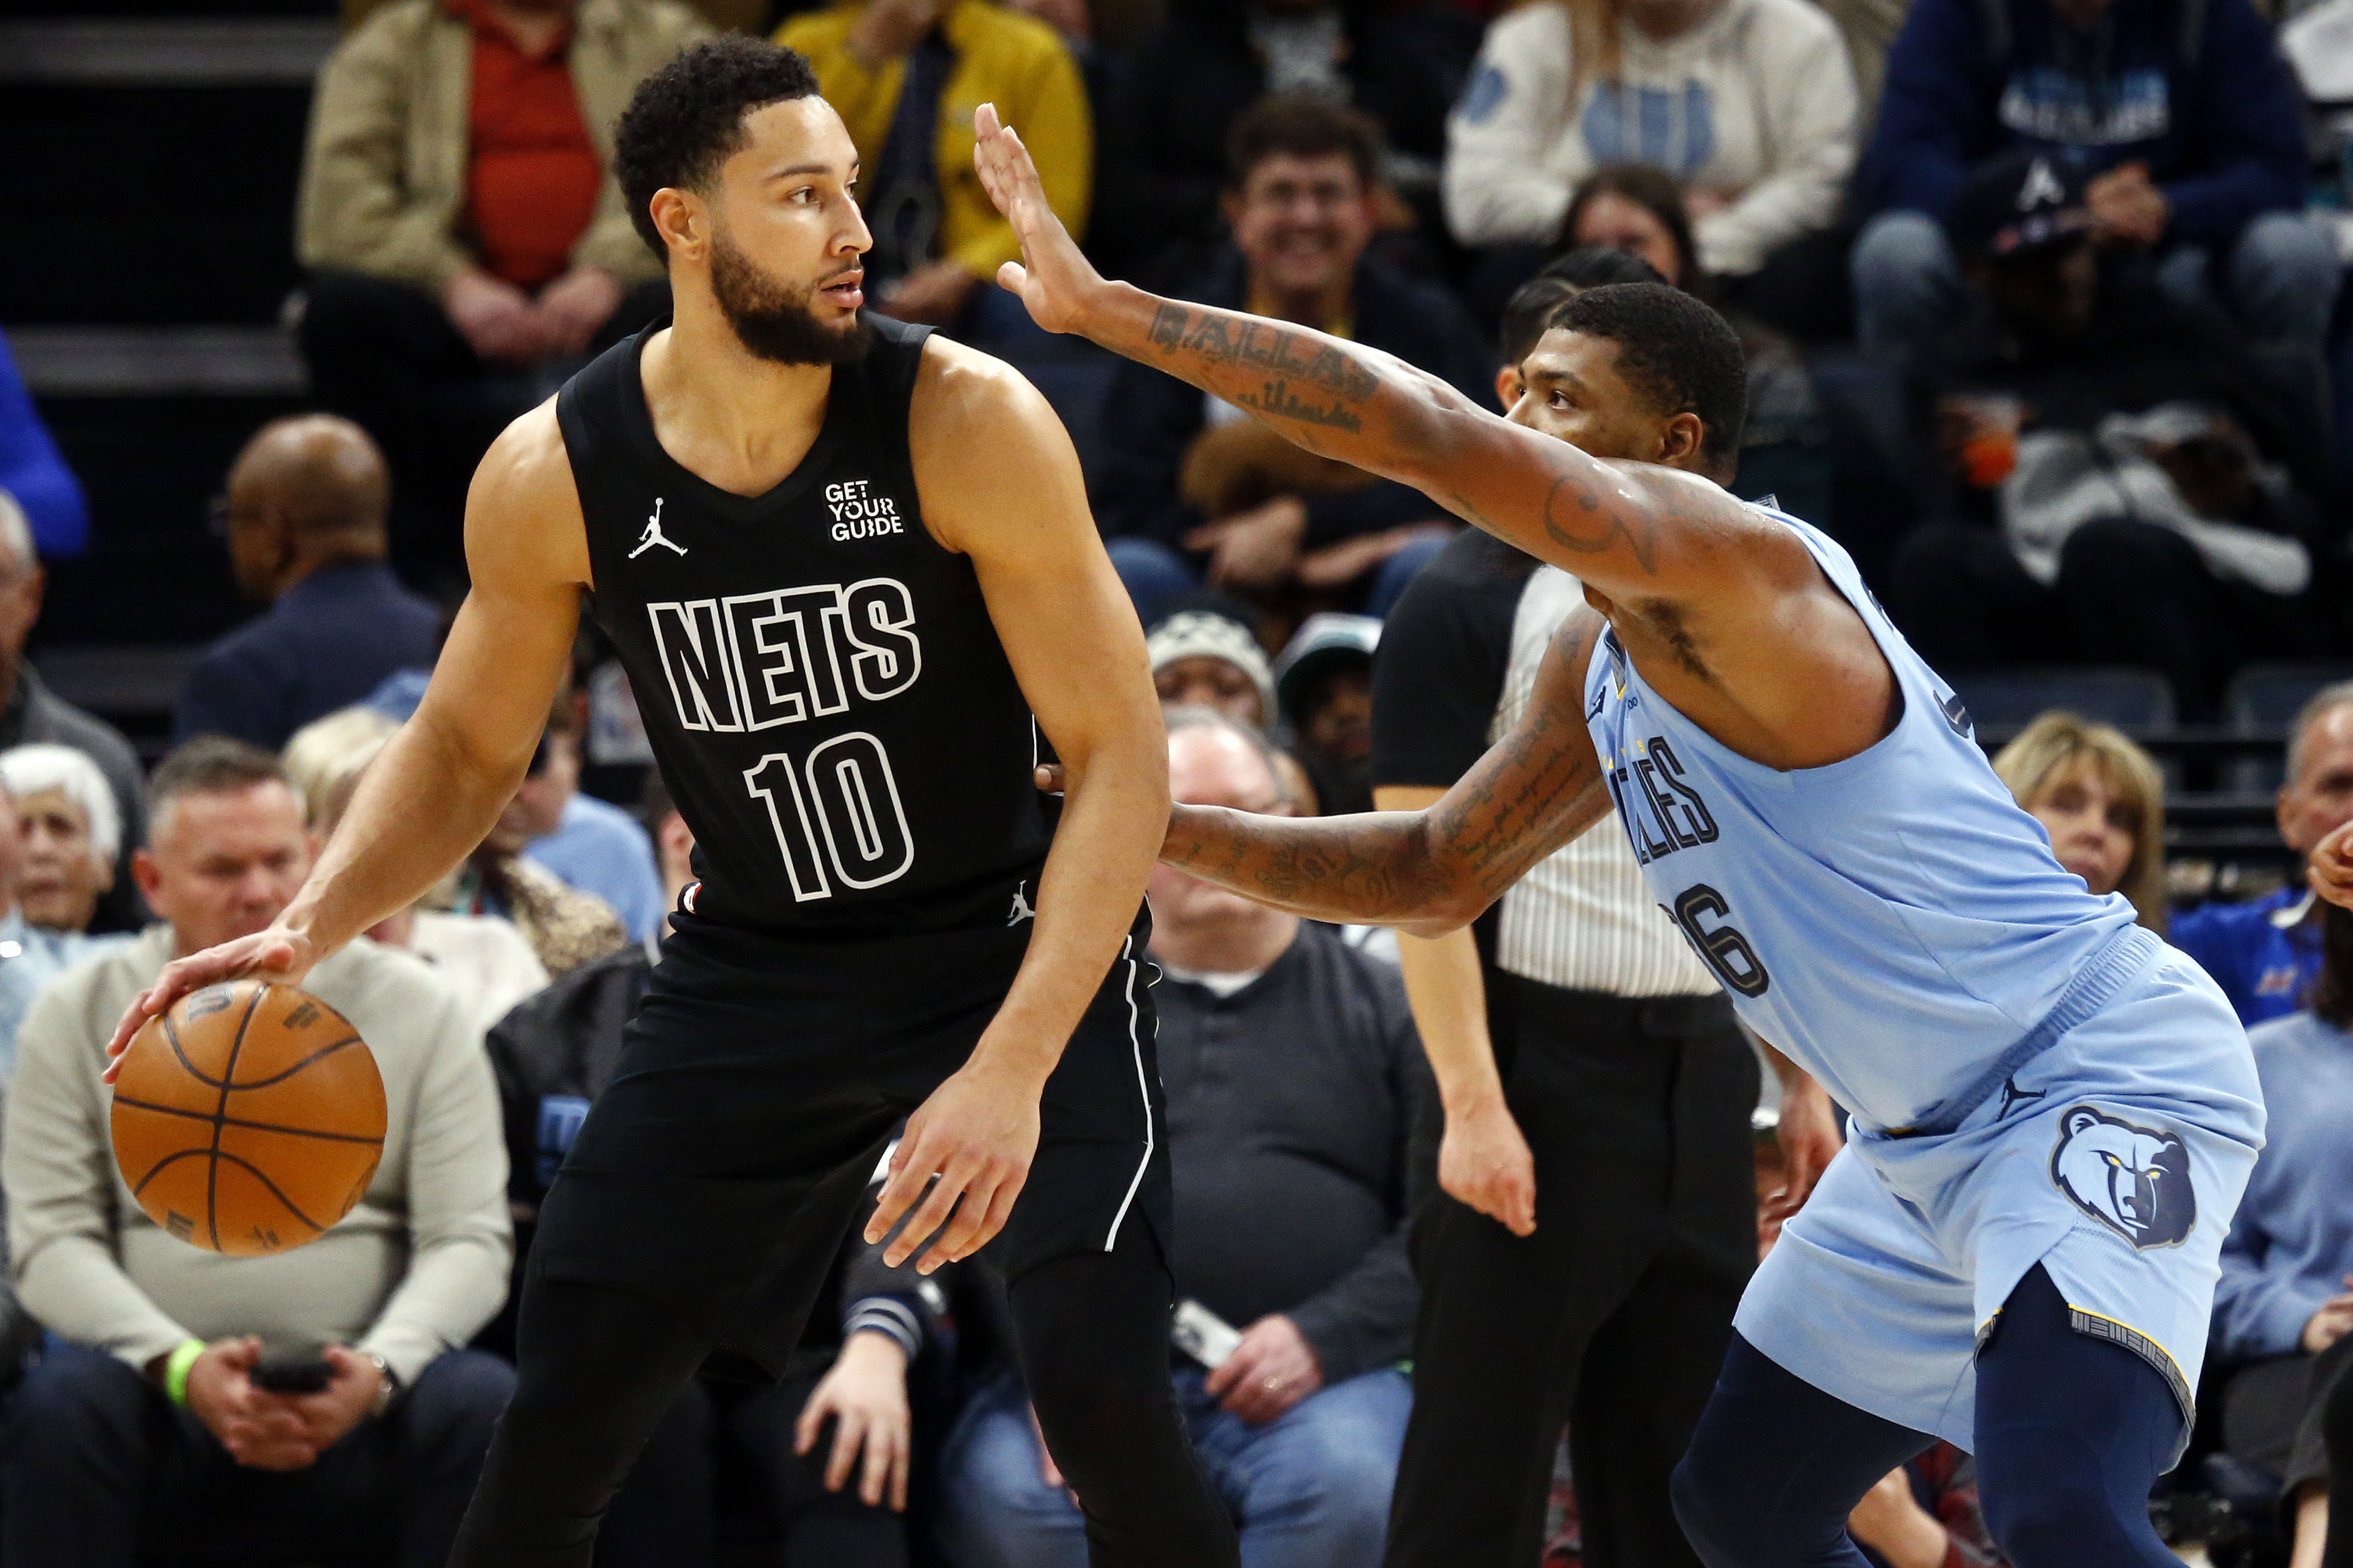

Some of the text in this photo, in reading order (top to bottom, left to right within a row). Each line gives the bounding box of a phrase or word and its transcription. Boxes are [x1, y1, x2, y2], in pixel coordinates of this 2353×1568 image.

[825, 480, 868, 502] GET
[828, 498, 895, 521] YOUR
[831, 516, 904, 541] GUIDE
[647, 577, 922, 733] NETS
[742, 731, 915, 902] 10
[1658, 883, 1770, 999] 6
